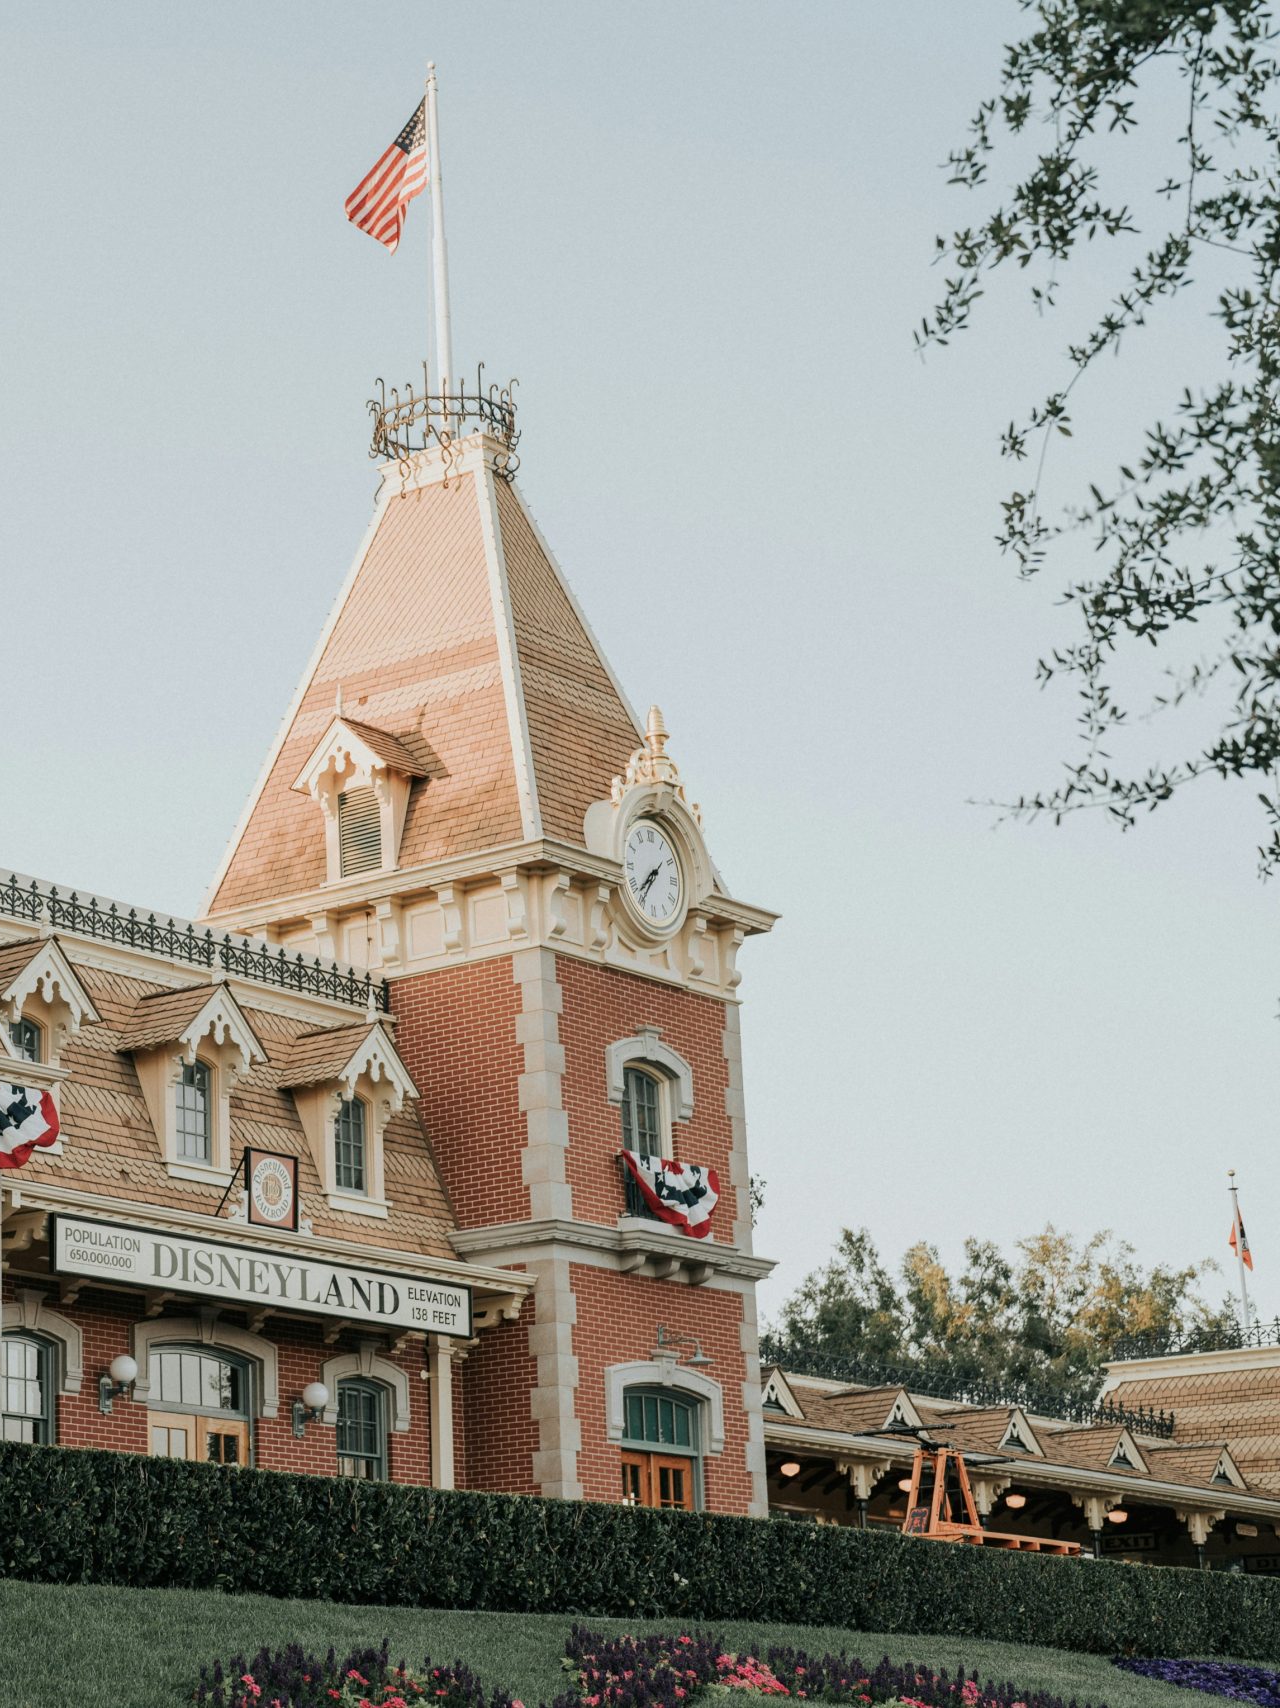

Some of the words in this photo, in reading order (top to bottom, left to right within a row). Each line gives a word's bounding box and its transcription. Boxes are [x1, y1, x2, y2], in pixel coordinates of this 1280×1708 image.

[255, 1194, 289, 1218] RAILROAD
[65, 1227, 141, 1253] POPULATION
[69, 1248, 132, 1269] 650,000,000
[150, 1242, 400, 1315] DISNEYLAND
[407, 1286, 461, 1308] ELEVATION
[412, 1307, 428, 1321] 138
[432, 1310, 457, 1326] FEET
[1105, 1536, 1153, 1548] EXIT
